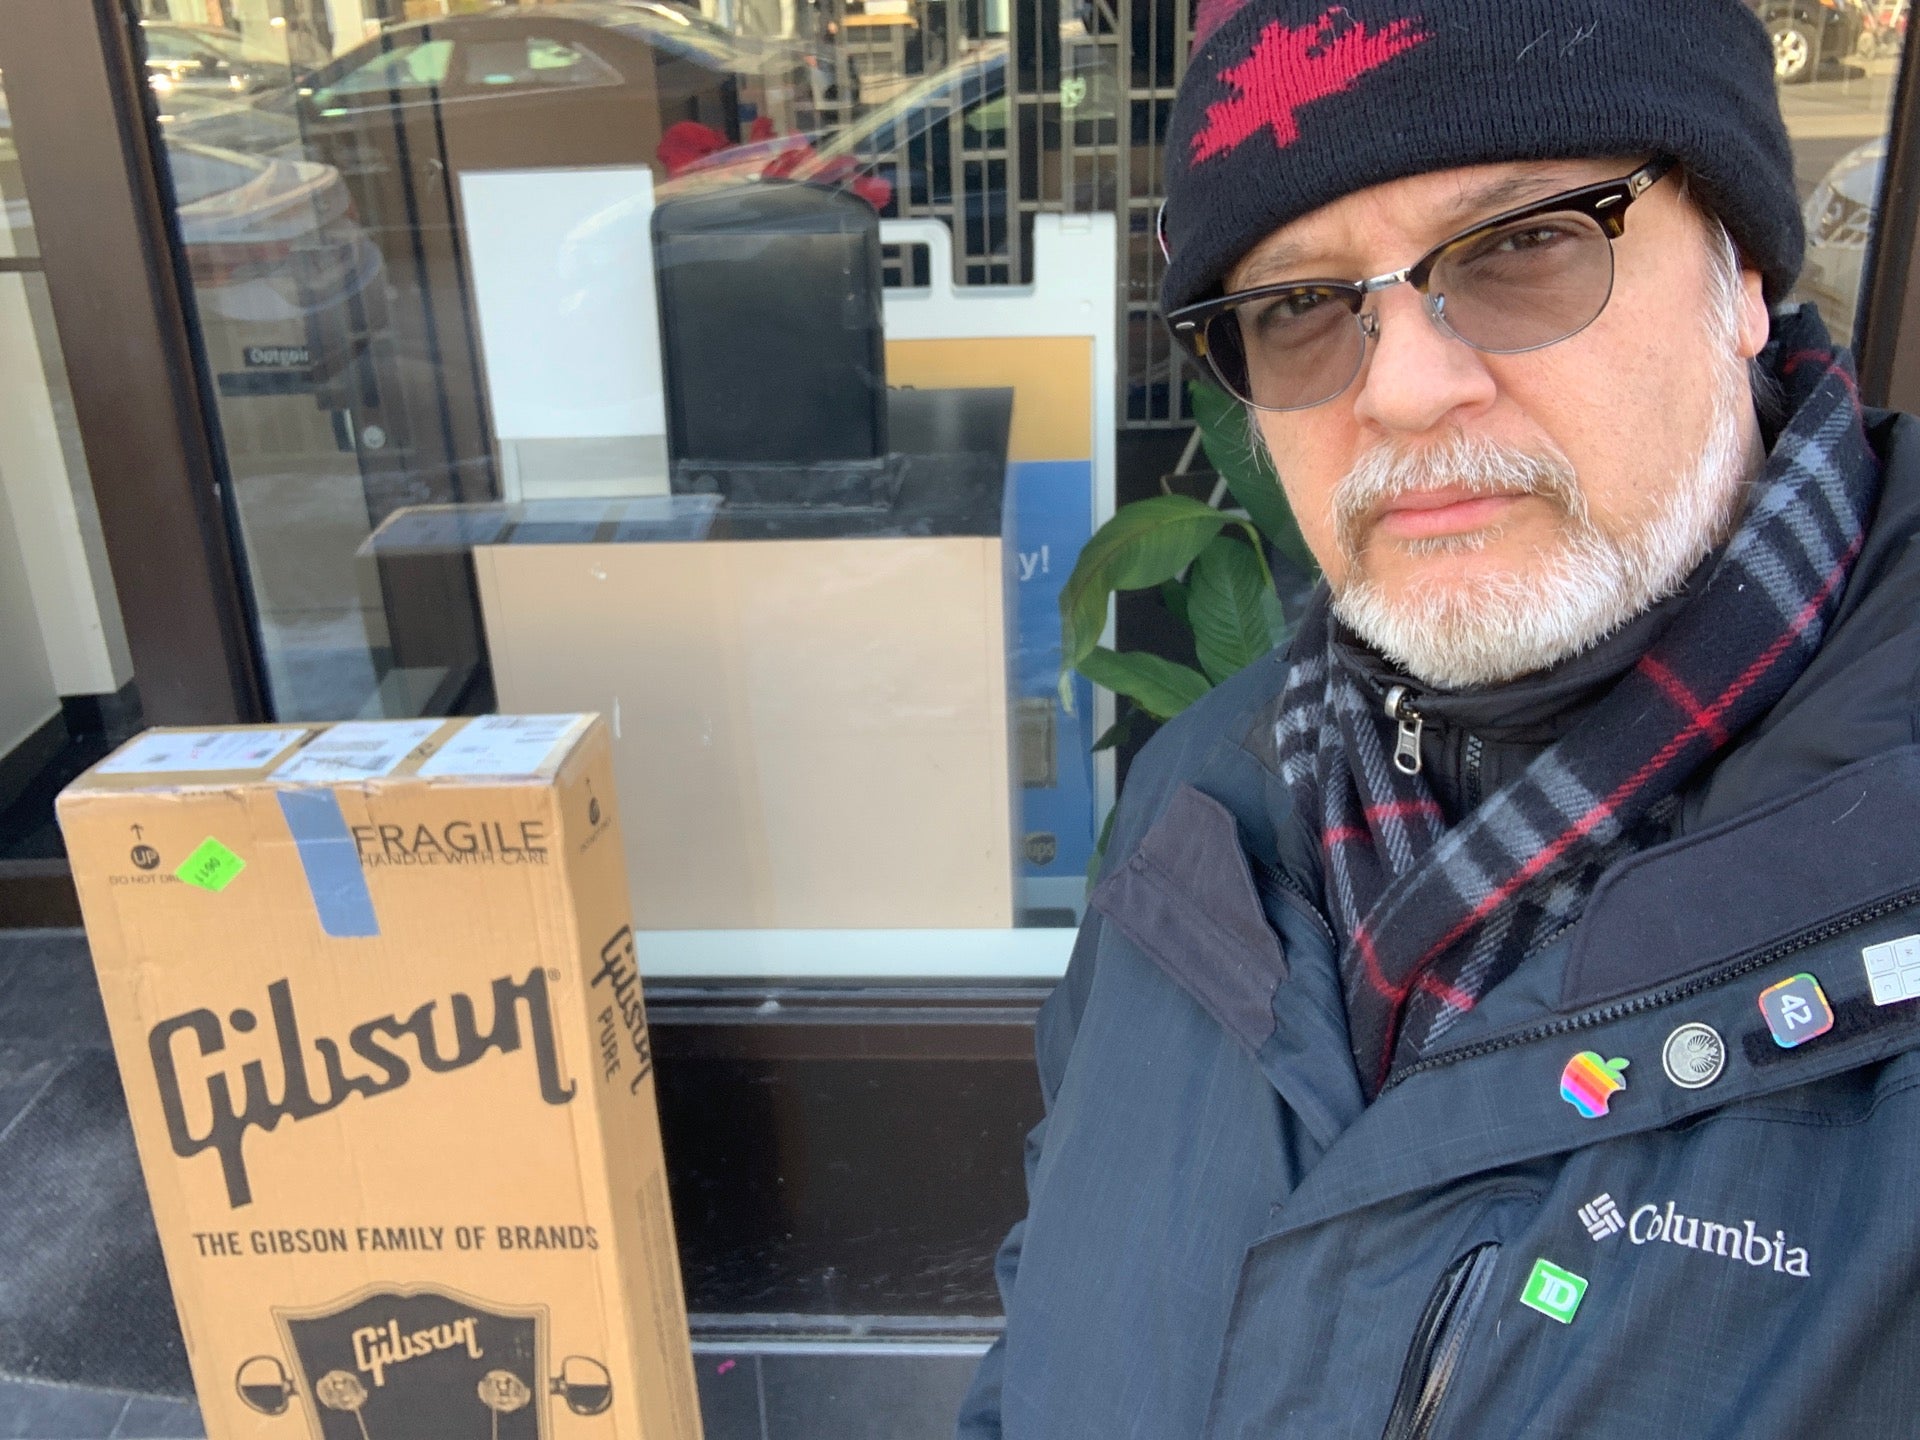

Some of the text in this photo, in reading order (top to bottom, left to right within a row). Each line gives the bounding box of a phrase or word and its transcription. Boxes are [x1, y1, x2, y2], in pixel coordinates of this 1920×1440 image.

[351, 821, 548, 856] FRAGILE
[133, 850, 158, 868] UP
[359, 850, 549, 868] HANDLE WITH CARE
[108, 874, 129, 886] DO
[131, 873, 156, 885] NOT
[1780, 994, 1813, 1031] 42
[597, 1006, 622, 1083] PURE
[148, 966, 578, 1210] Gibson
[192, 1225, 600, 1257] THE GIBSON FAMILY OF BRANDS
[1629, 1201, 1811, 1278] Columbia
[1536, 1269, 1578, 1312] TD
[352, 1316, 484, 1388] Gibson
